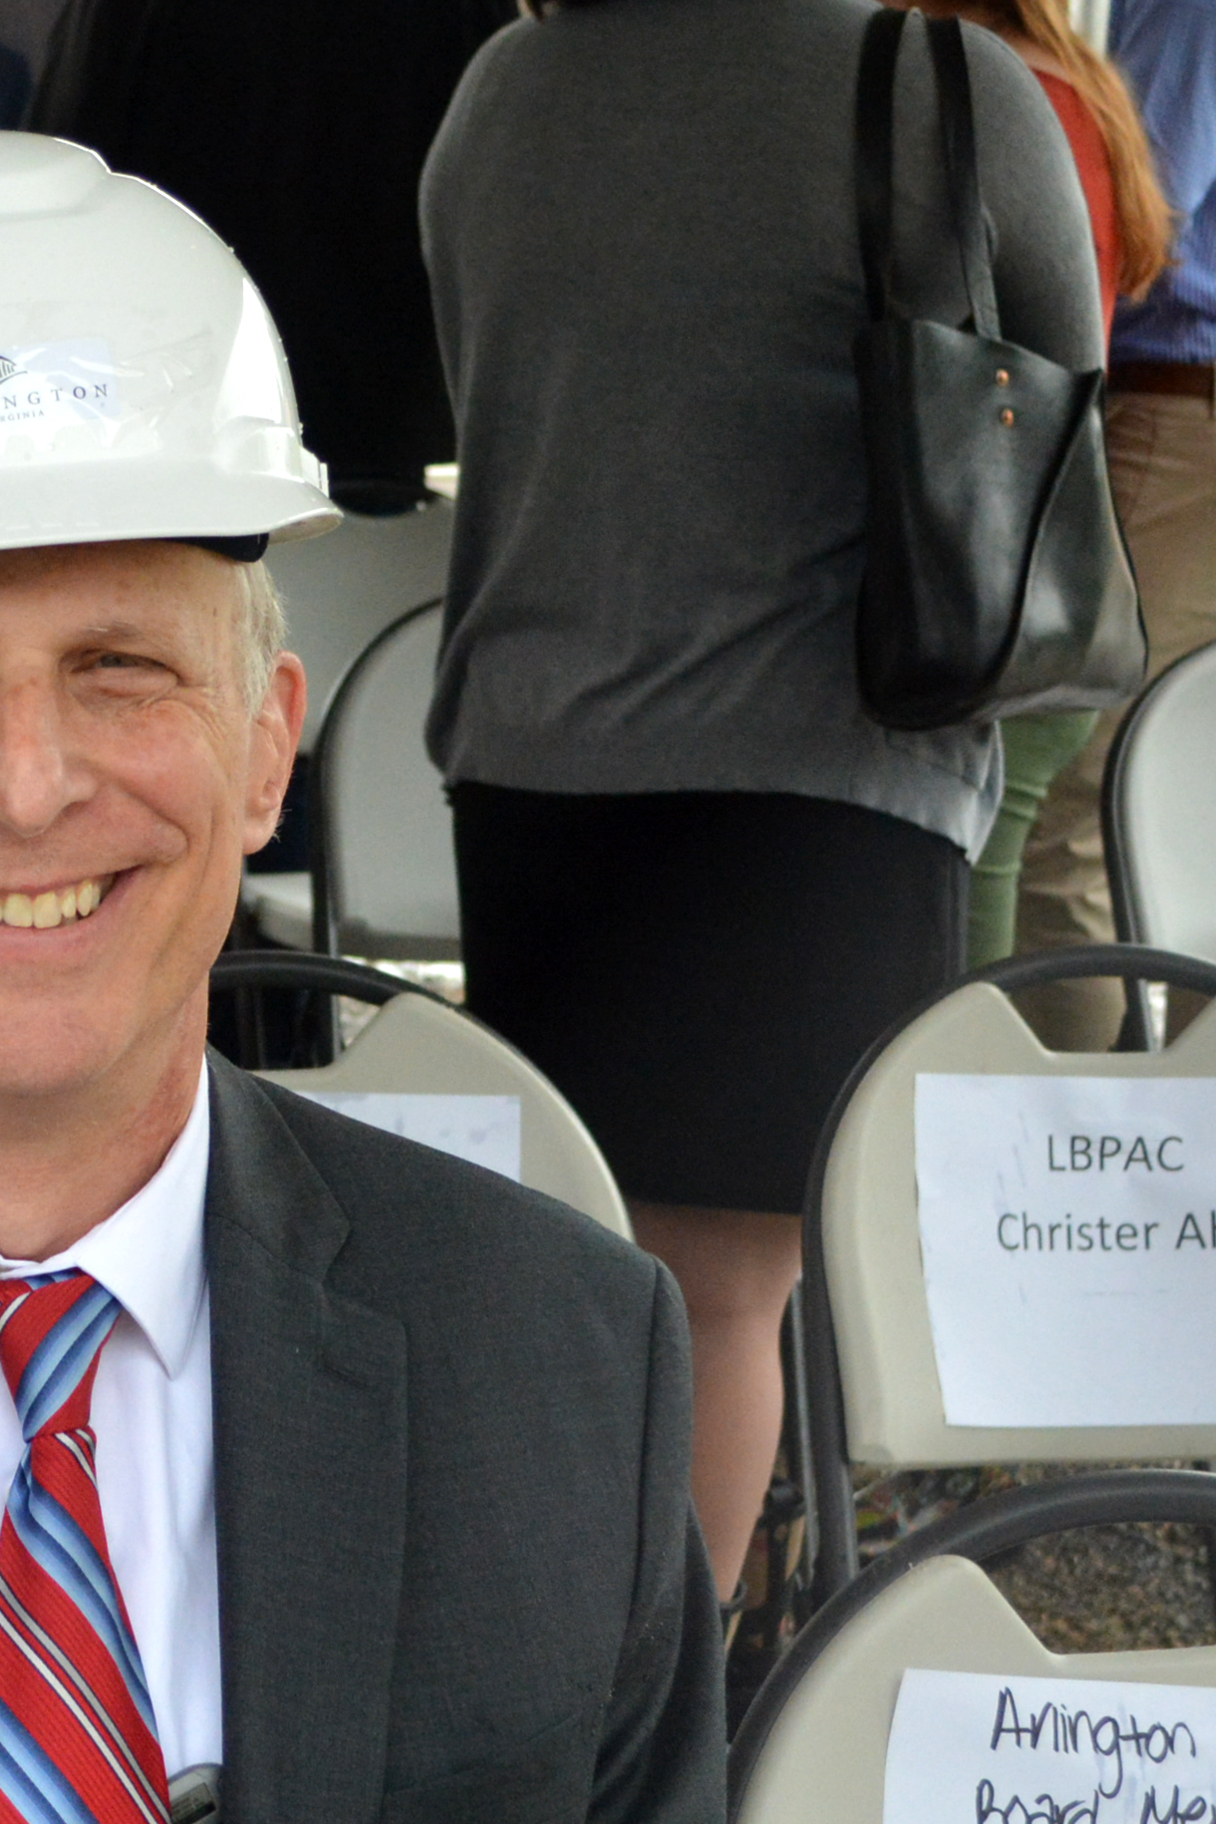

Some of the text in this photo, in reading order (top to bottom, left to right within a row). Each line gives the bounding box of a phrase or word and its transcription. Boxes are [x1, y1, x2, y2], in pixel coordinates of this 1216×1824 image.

[1048, 1134, 1184, 1172] LBPAC
[996, 1211, 1159, 1251] Christer
[990, 1686, 1197, 1799] Arlington
